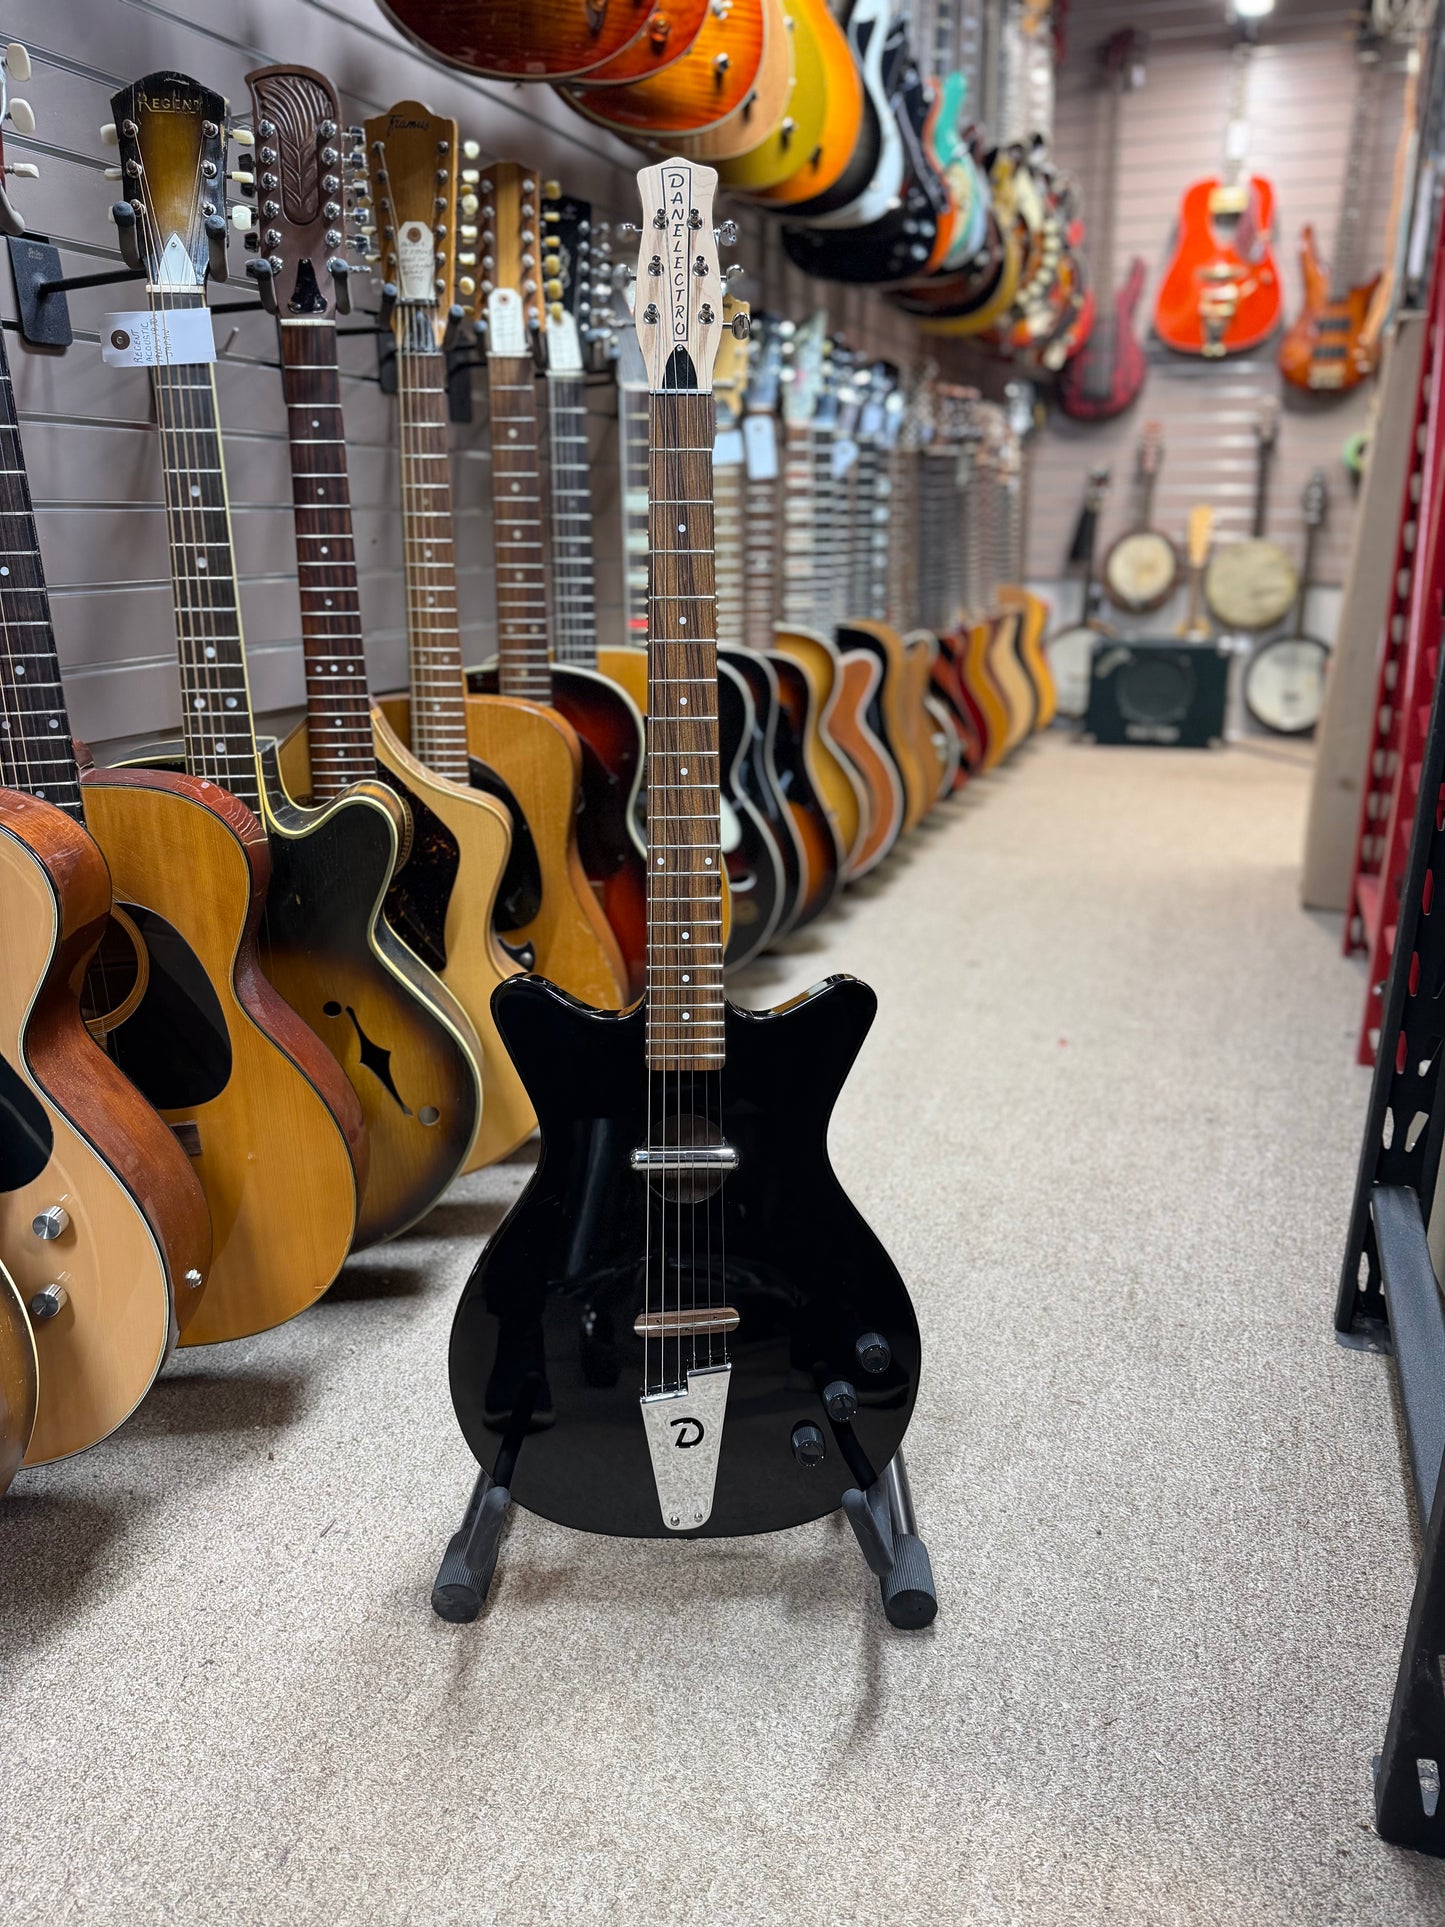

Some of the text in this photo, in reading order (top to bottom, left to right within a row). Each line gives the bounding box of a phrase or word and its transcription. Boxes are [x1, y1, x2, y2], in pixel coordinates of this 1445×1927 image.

[387, 114, 429, 137] Framus
[667, 173, 686, 335] DANELECTRO
[131, 329, 144, 363] REGENT
[141, 322, 153, 362] ACOUSTIC
[670, 1417, 704, 1448] D
